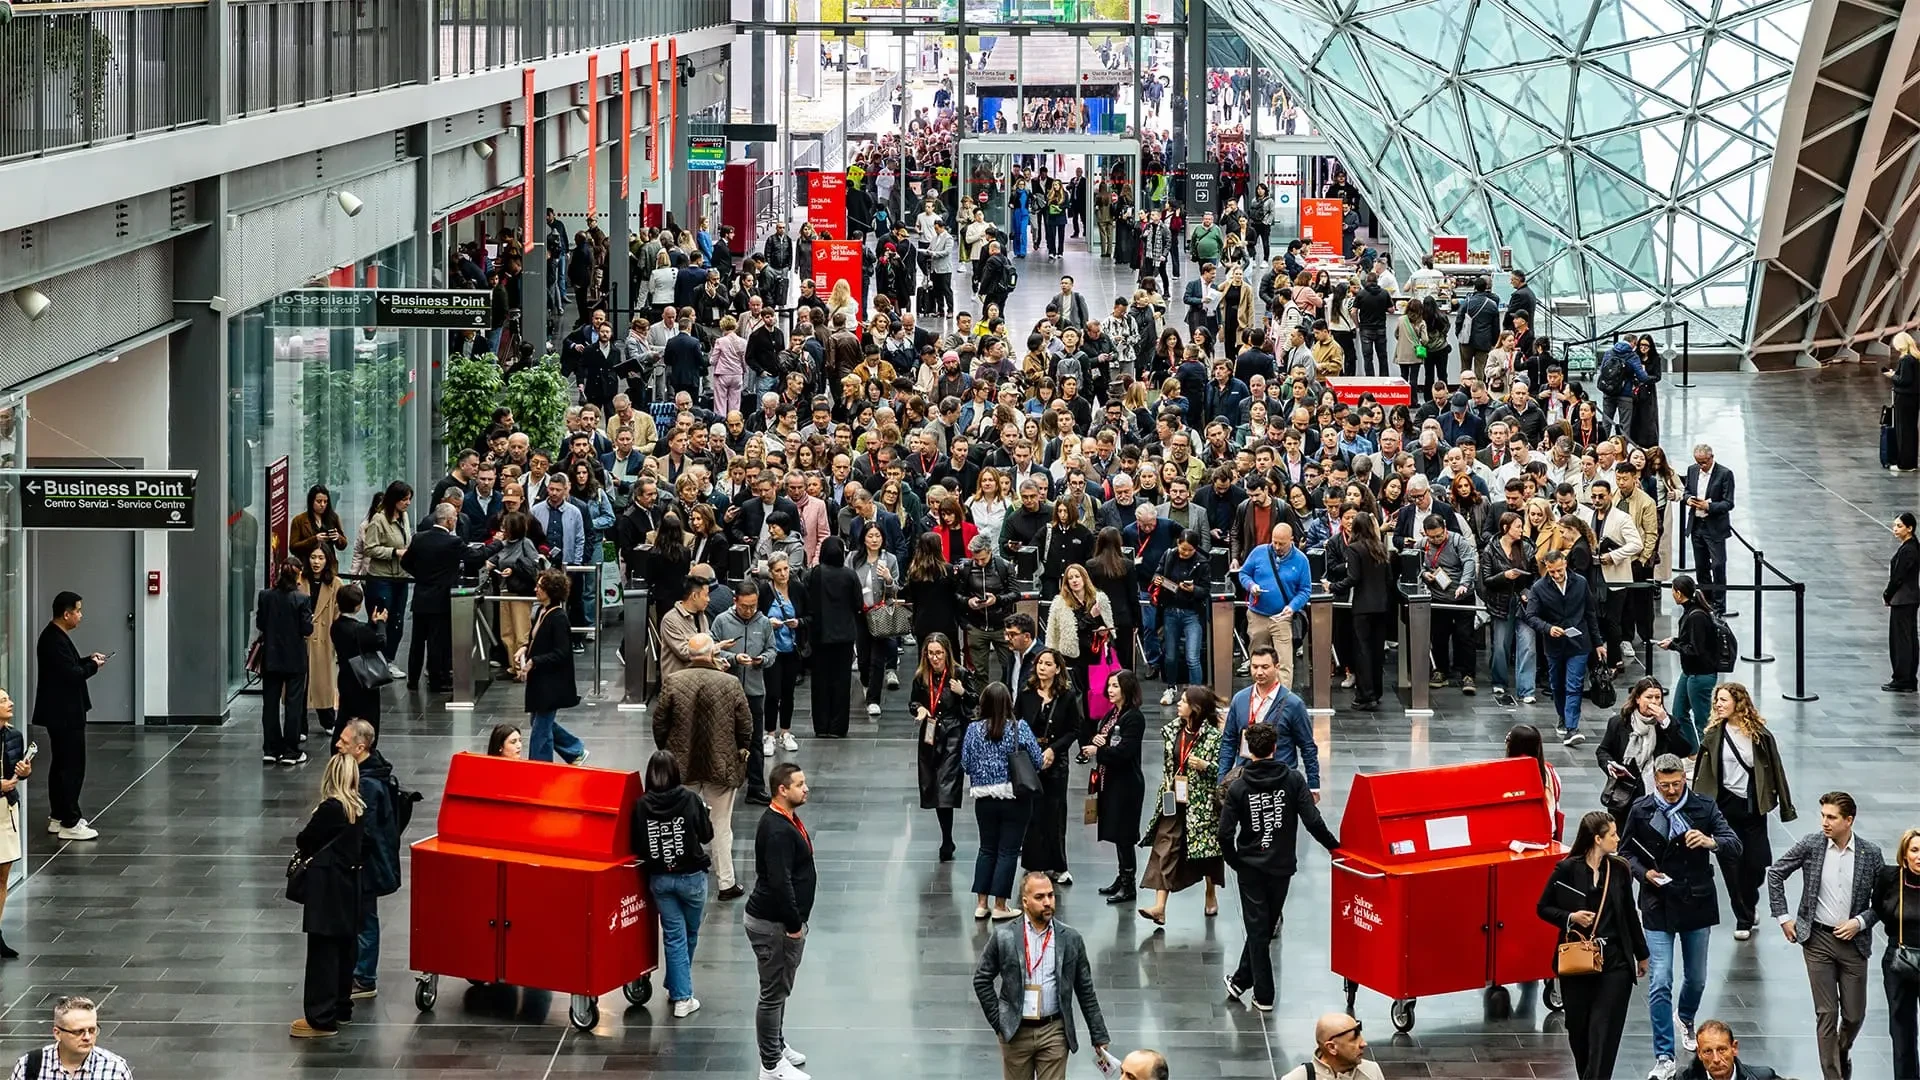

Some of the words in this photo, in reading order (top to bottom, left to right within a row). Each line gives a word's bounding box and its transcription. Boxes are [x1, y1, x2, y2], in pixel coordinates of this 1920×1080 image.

[391, 295, 449, 306] Business
[452, 296, 485, 307] Point
[44, 480, 130, 496] Business
[135, 481, 184, 496] Point
[44, 499, 76, 508] Centro
[78, 499, 109, 508] Servizi
[117, 500, 152, 509] Service
[154, 500, 186, 509] Centre
[1260, 792, 1273, 810] del
[1273, 789, 1286, 829] Salone
[1248, 793, 1262, 832] Milano
[646, 819, 660, 859] Milano
[672, 816, 685, 855] Salone
[620, 894, 638, 908] Salone
[1354, 894, 1374, 911] Salone
[621, 906, 630, 918] del
[1354, 905, 1363, 917] del
[621, 915, 638, 929] Milano
[1354, 915, 1373, 932] Milano
